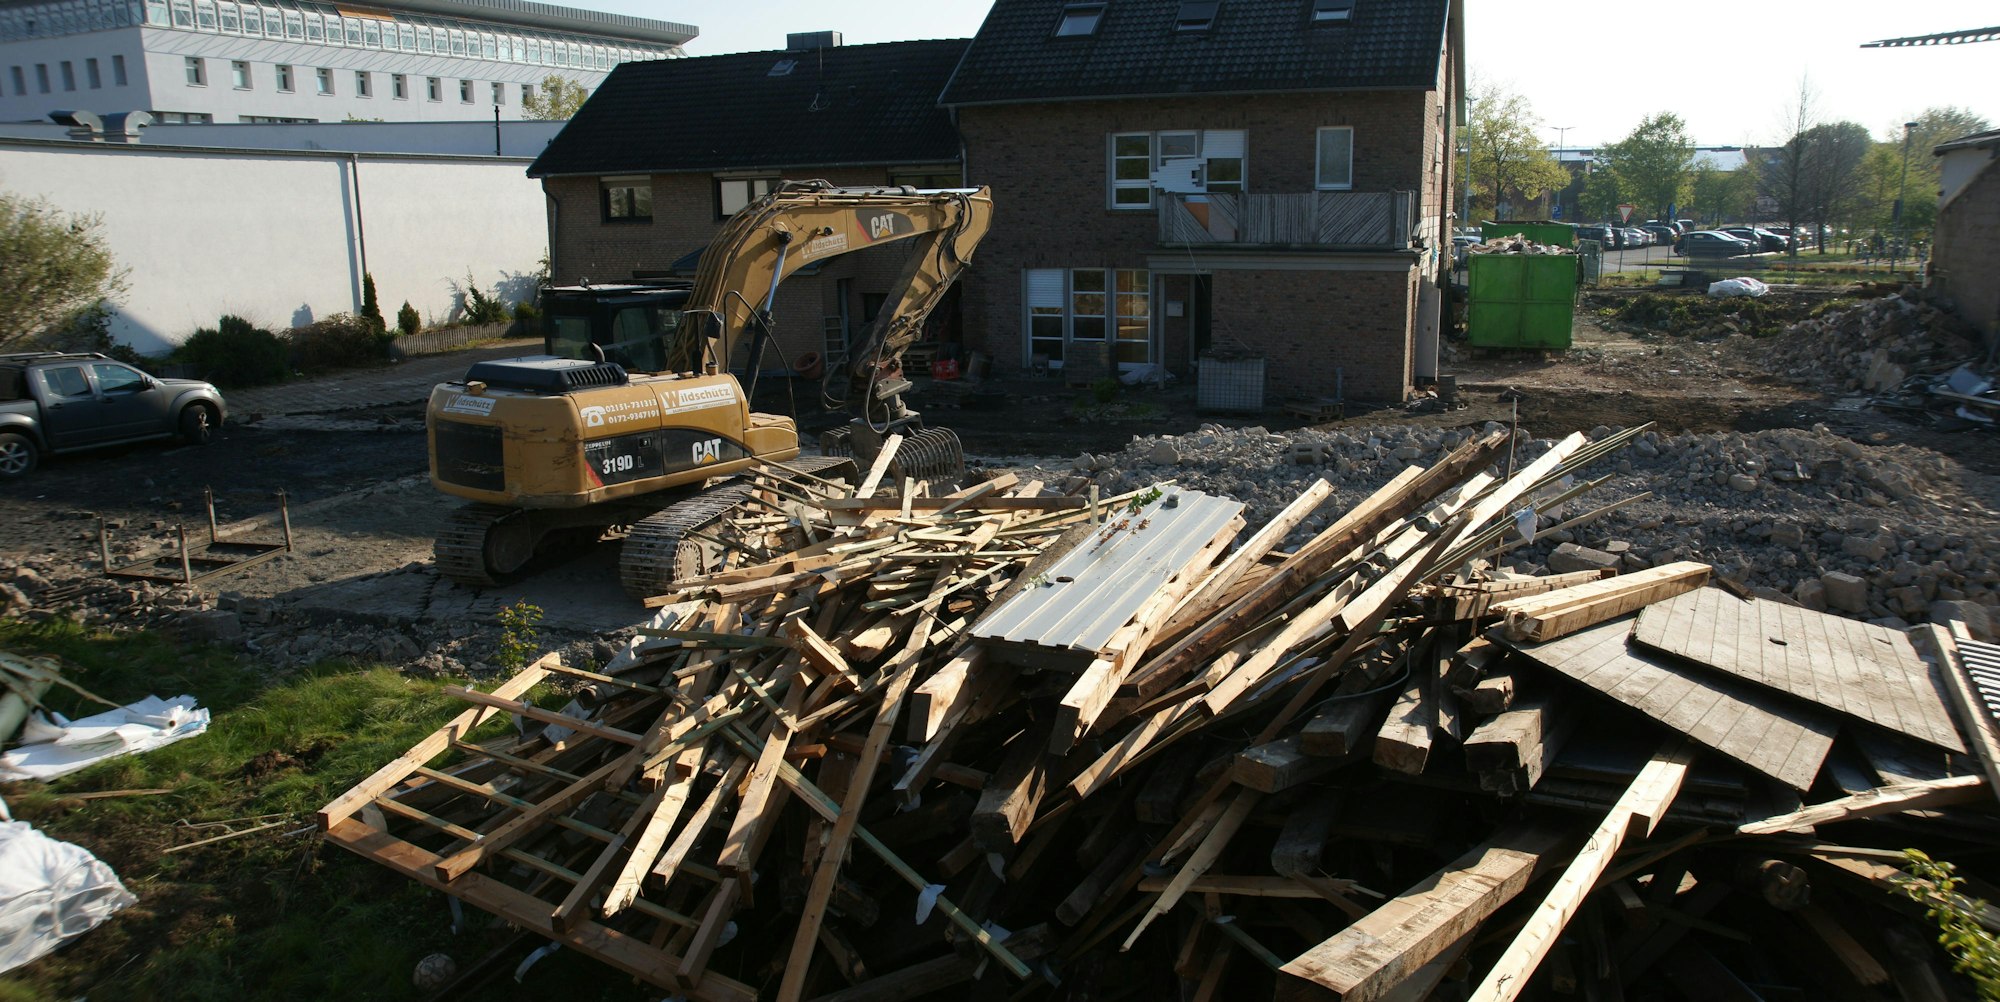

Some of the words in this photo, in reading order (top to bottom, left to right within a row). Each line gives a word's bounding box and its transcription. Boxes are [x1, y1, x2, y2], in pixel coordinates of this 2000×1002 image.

[871, 213, 894, 239] CAT
[660, 385, 731, 409] Wildschütz
[692, 438, 721, 465] CAT
[602, 454, 634, 475] 319D
[638, 456, 644, 468] L
